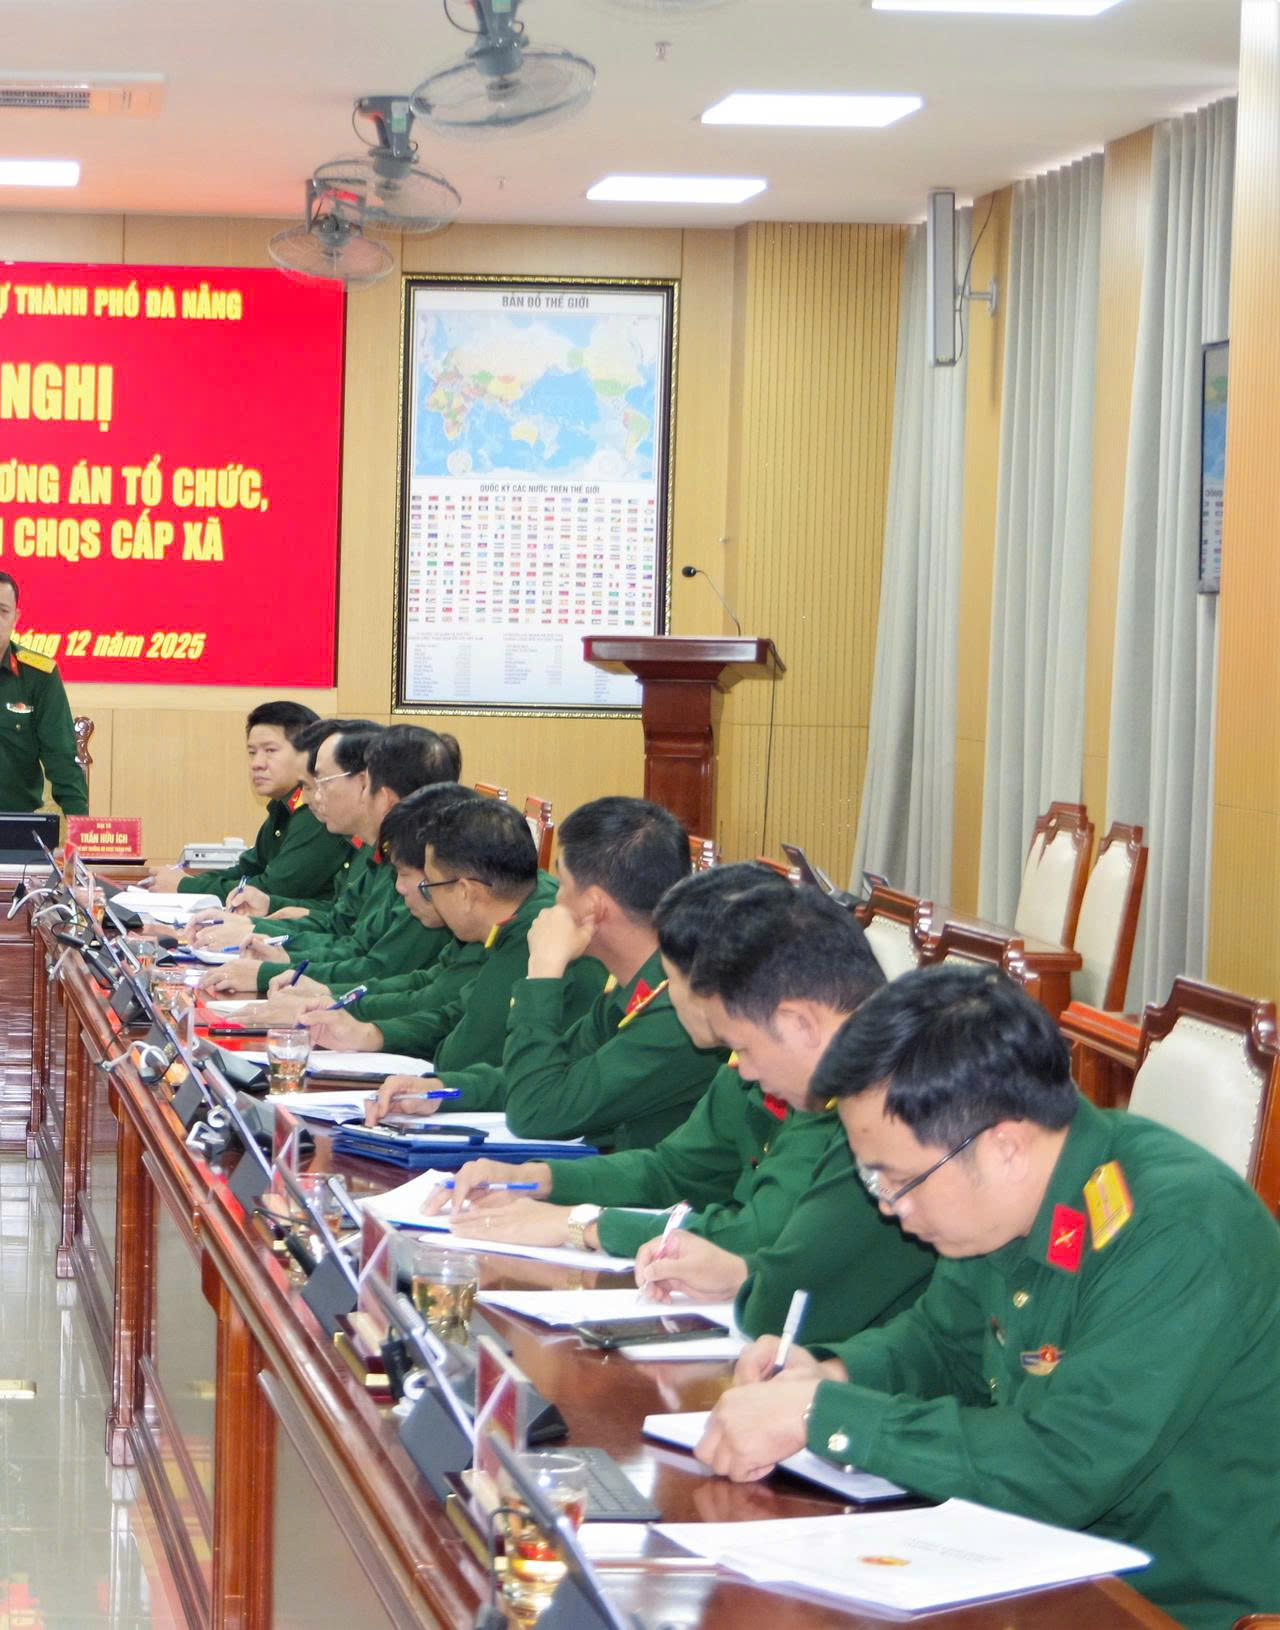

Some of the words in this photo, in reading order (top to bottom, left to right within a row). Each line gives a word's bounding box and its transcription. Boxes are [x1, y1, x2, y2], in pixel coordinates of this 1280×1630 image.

[14, 282, 88, 316] THÀNH
[93, 280, 139, 317] PHỐ
[145, 286, 176, 318] ĐÀ
[0, 363, 113, 432] NGHỊ
[68, 460, 112, 505] ÁN
[121, 453, 163, 506] TỔ
[172, 463, 268, 512] CHỨC,
[13, 517, 101, 562] CHQS
[111, 507, 174, 560] CẤP
[182, 516, 224, 561] XÃ
[11, 628, 61, 659] háng
[65, 629, 92, 656] 12
[92, 631, 145, 657] năm
[146, 632, 206, 659] 2025
